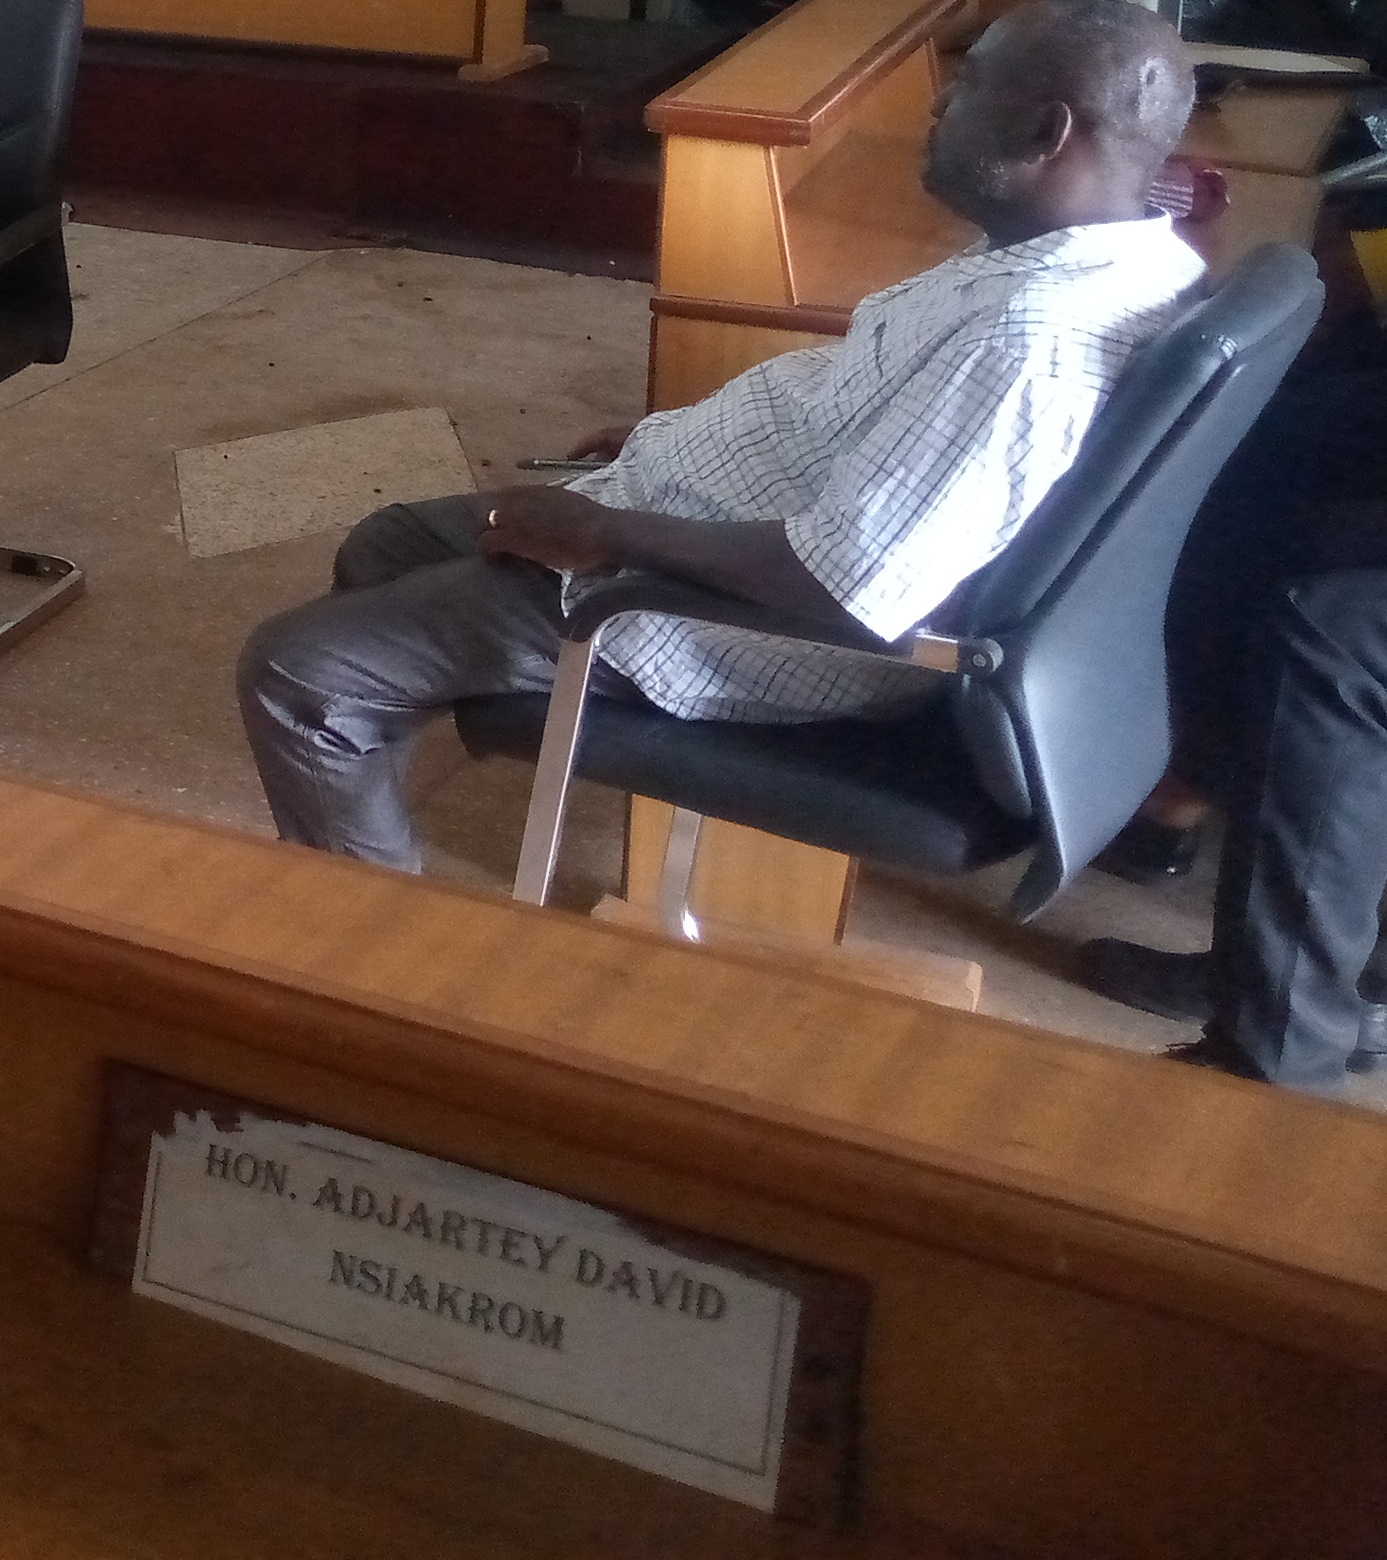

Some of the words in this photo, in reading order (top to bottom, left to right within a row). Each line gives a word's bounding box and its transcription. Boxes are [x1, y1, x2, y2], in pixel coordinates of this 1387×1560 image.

[203, 1143, 298, 1201] HON.
[314, 1177, 567, 1273] ADJARTEY
[574, 1247, 729, 1323] DAVID
[328, 1249, 565, 1351] NSIAKROM
